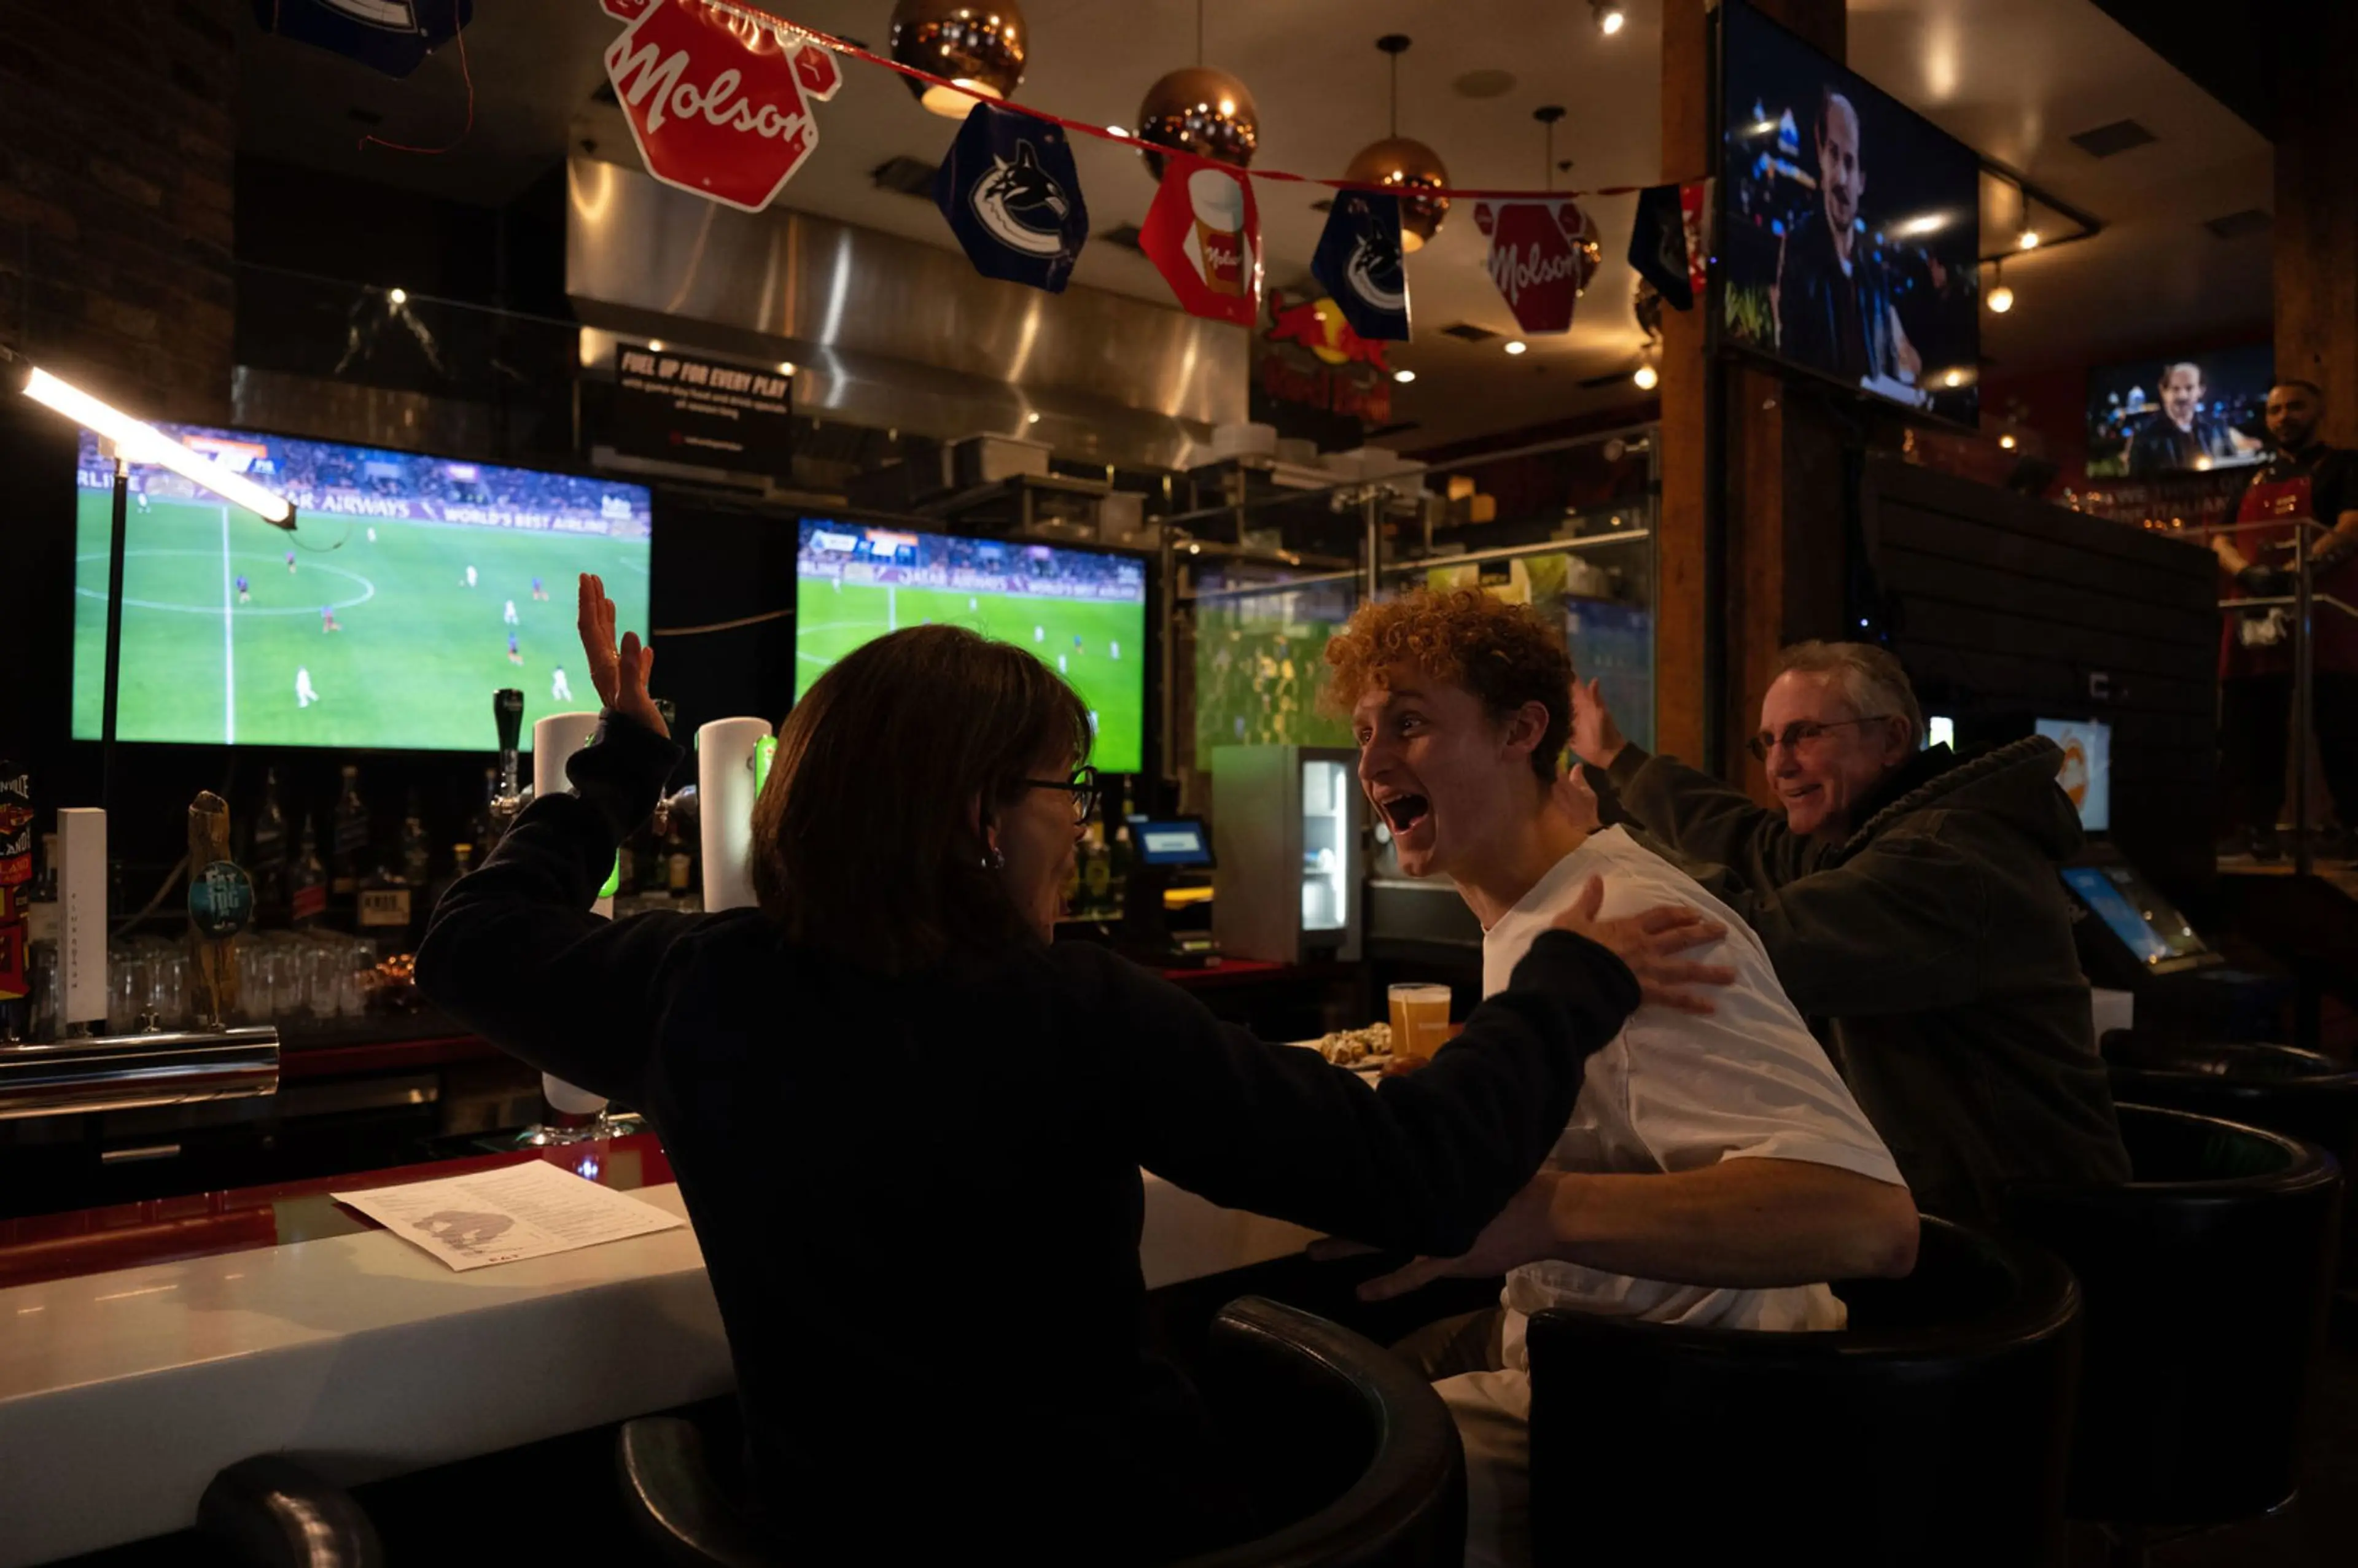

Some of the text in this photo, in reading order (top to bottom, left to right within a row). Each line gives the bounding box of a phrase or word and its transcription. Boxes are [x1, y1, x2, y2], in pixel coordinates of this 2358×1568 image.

[614, 36, 817, 148] Molson
[1488, 242, 1582, 307] Molson
[621, 352, 788, 398] FUEL UP FOR EVERY PLAY
[77, 470, 142, 491] RLIE
[321, 494, 411, 518] AIRWAYS
